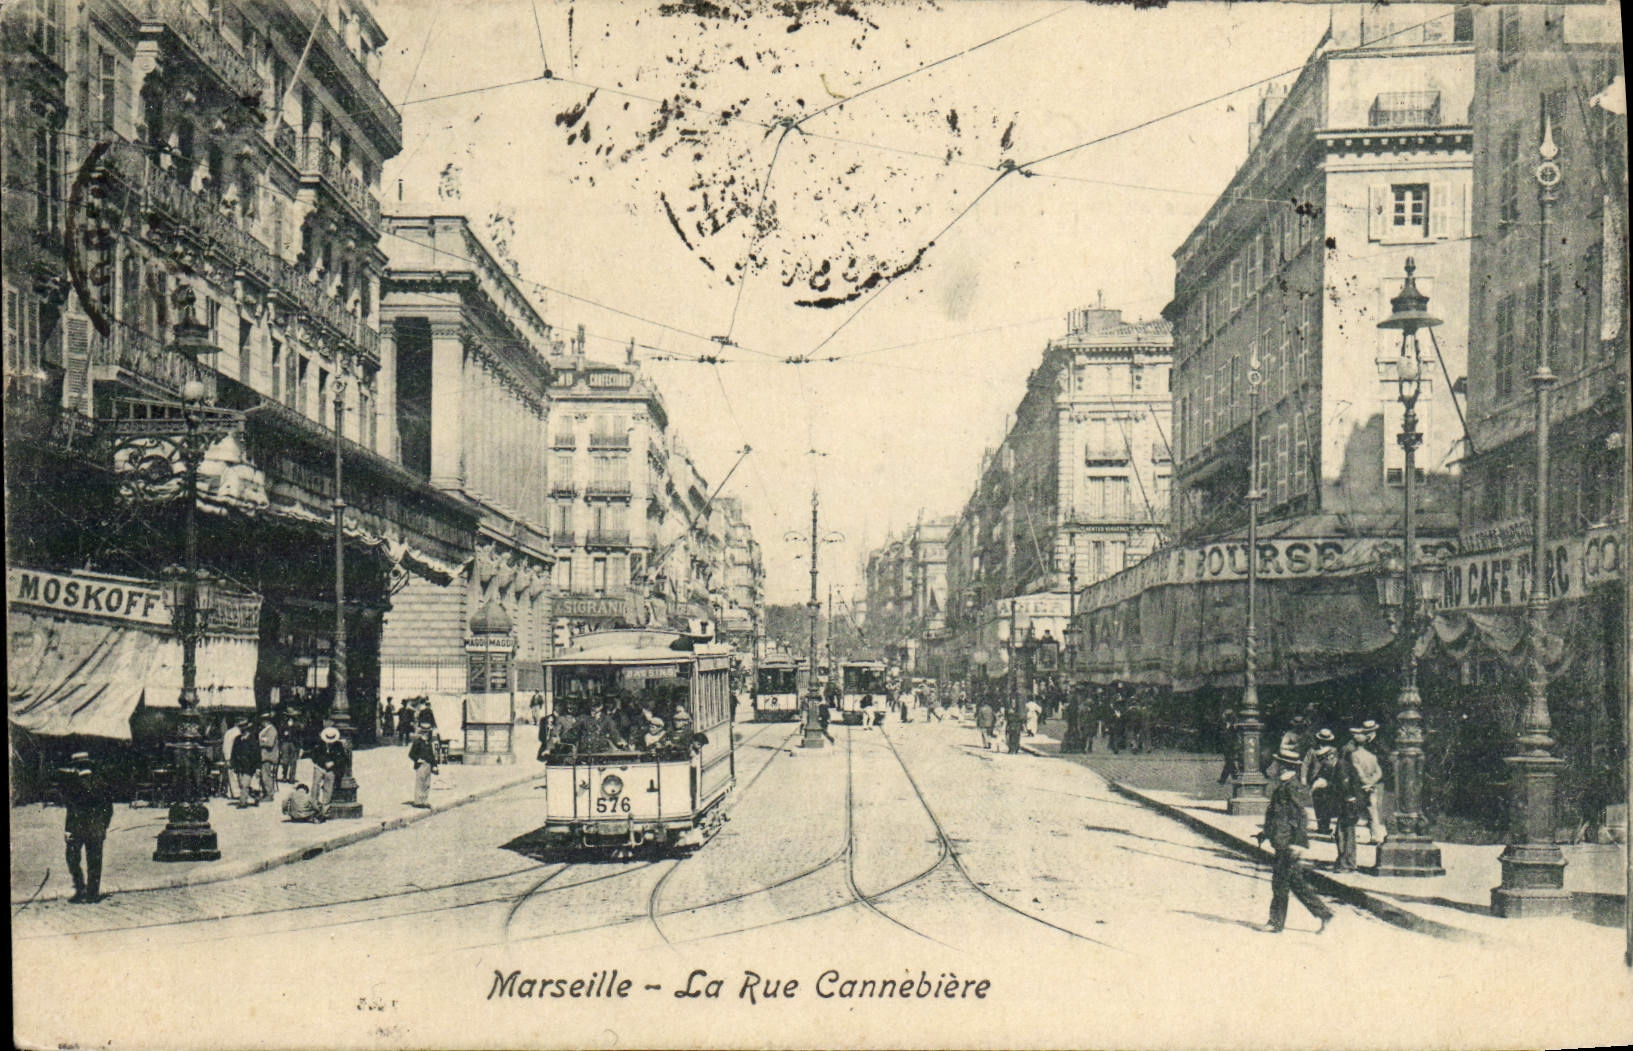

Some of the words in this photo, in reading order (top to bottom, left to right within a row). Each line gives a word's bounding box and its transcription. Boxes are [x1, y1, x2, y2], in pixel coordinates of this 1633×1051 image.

[18, 573, 163, 618] MOSKOFF
[1517, 545, 1570, 602] TRC
[596, 797, 632, 813] 576
